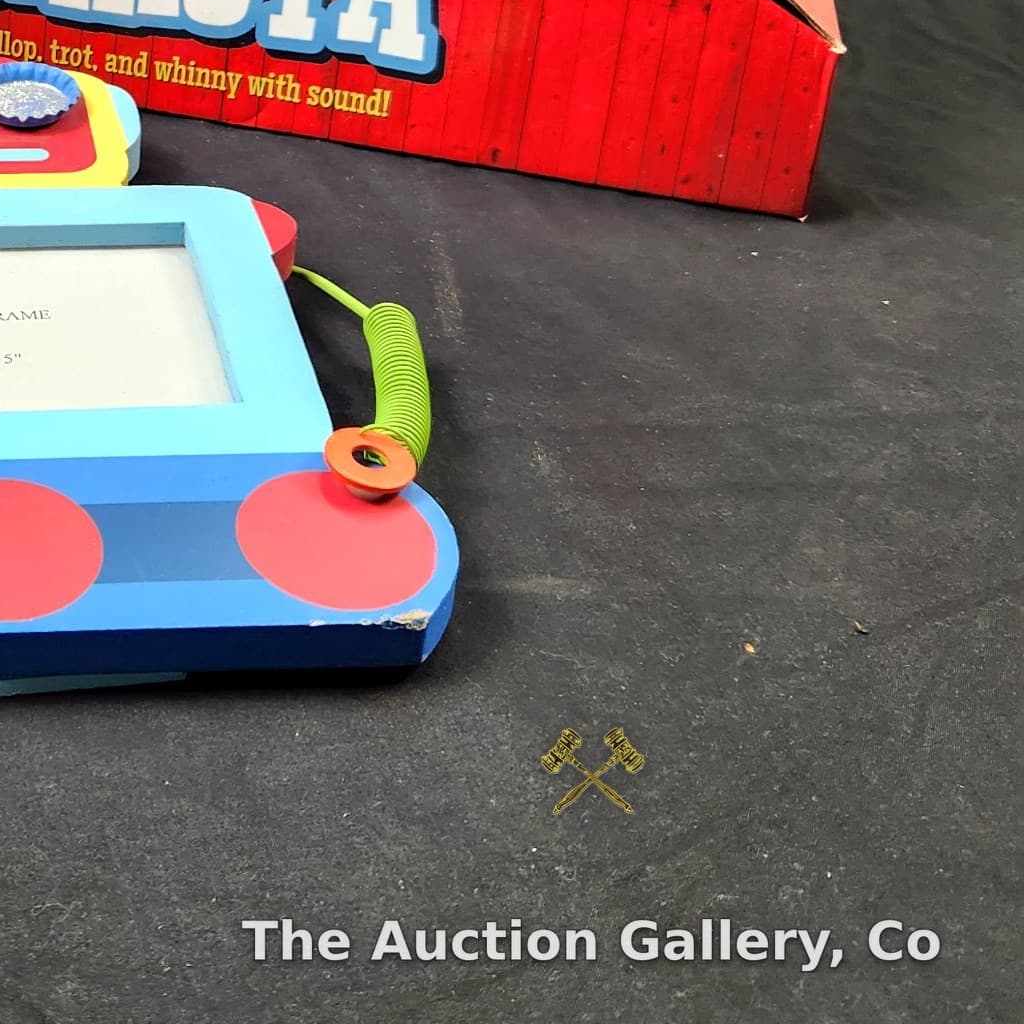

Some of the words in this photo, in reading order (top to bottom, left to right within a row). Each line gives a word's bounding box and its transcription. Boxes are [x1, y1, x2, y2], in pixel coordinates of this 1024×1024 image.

[104, 51, 149, 78] and
[154, 55, 243, 99] whinny
[248, 73, 301, 104] with
[306, 88, 393, 117] sound!
[3, 353, 22, 365] 5"
